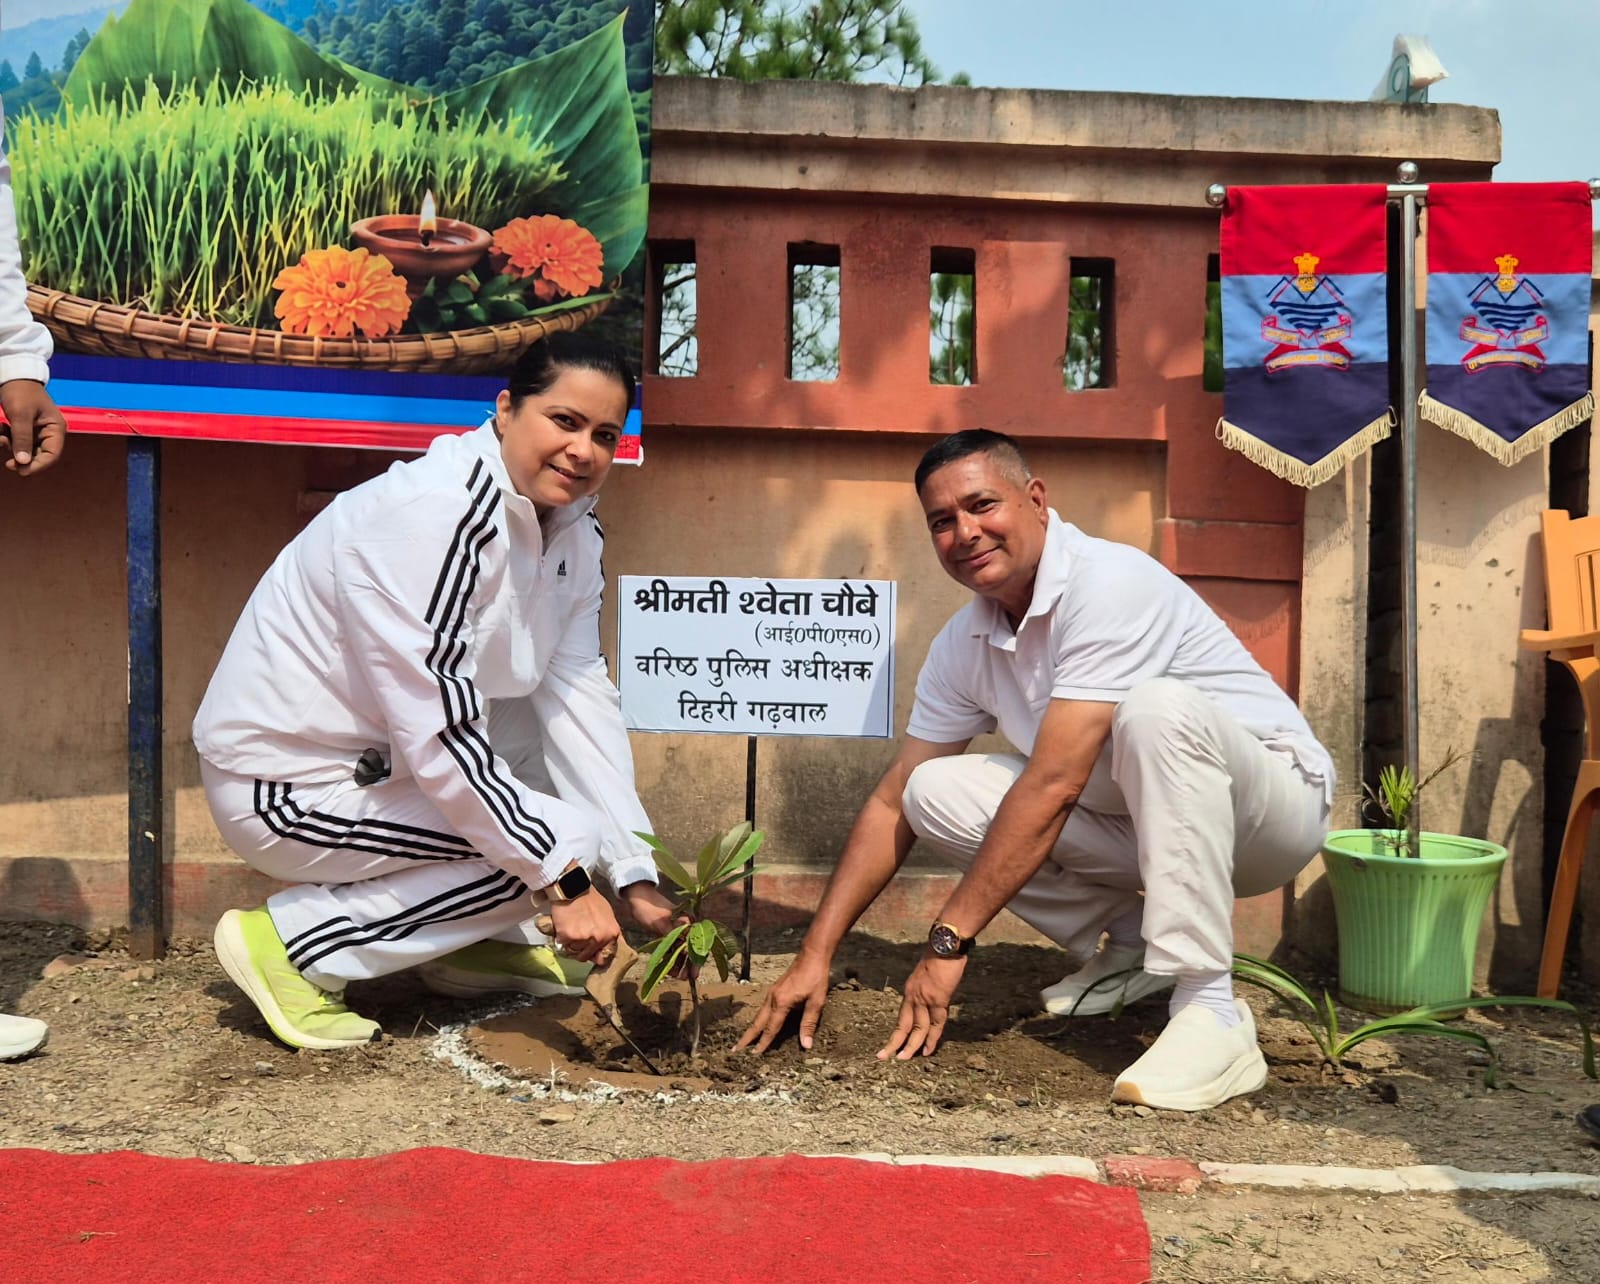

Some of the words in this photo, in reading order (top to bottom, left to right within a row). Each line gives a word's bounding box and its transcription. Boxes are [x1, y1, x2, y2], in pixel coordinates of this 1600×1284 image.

[633, 579, 730, 614] श्रीमती
[821, 583, 879, 617] चौबे
[635, 647, 699, 677] वरिष्ठ
[706, 648, 771, 688] पुलिस
[781, 651, 873, 682] अधीक्षक
[677, 690, 738, 723] टिहरी
[746, 701, 828, 729] गढ़वाल
